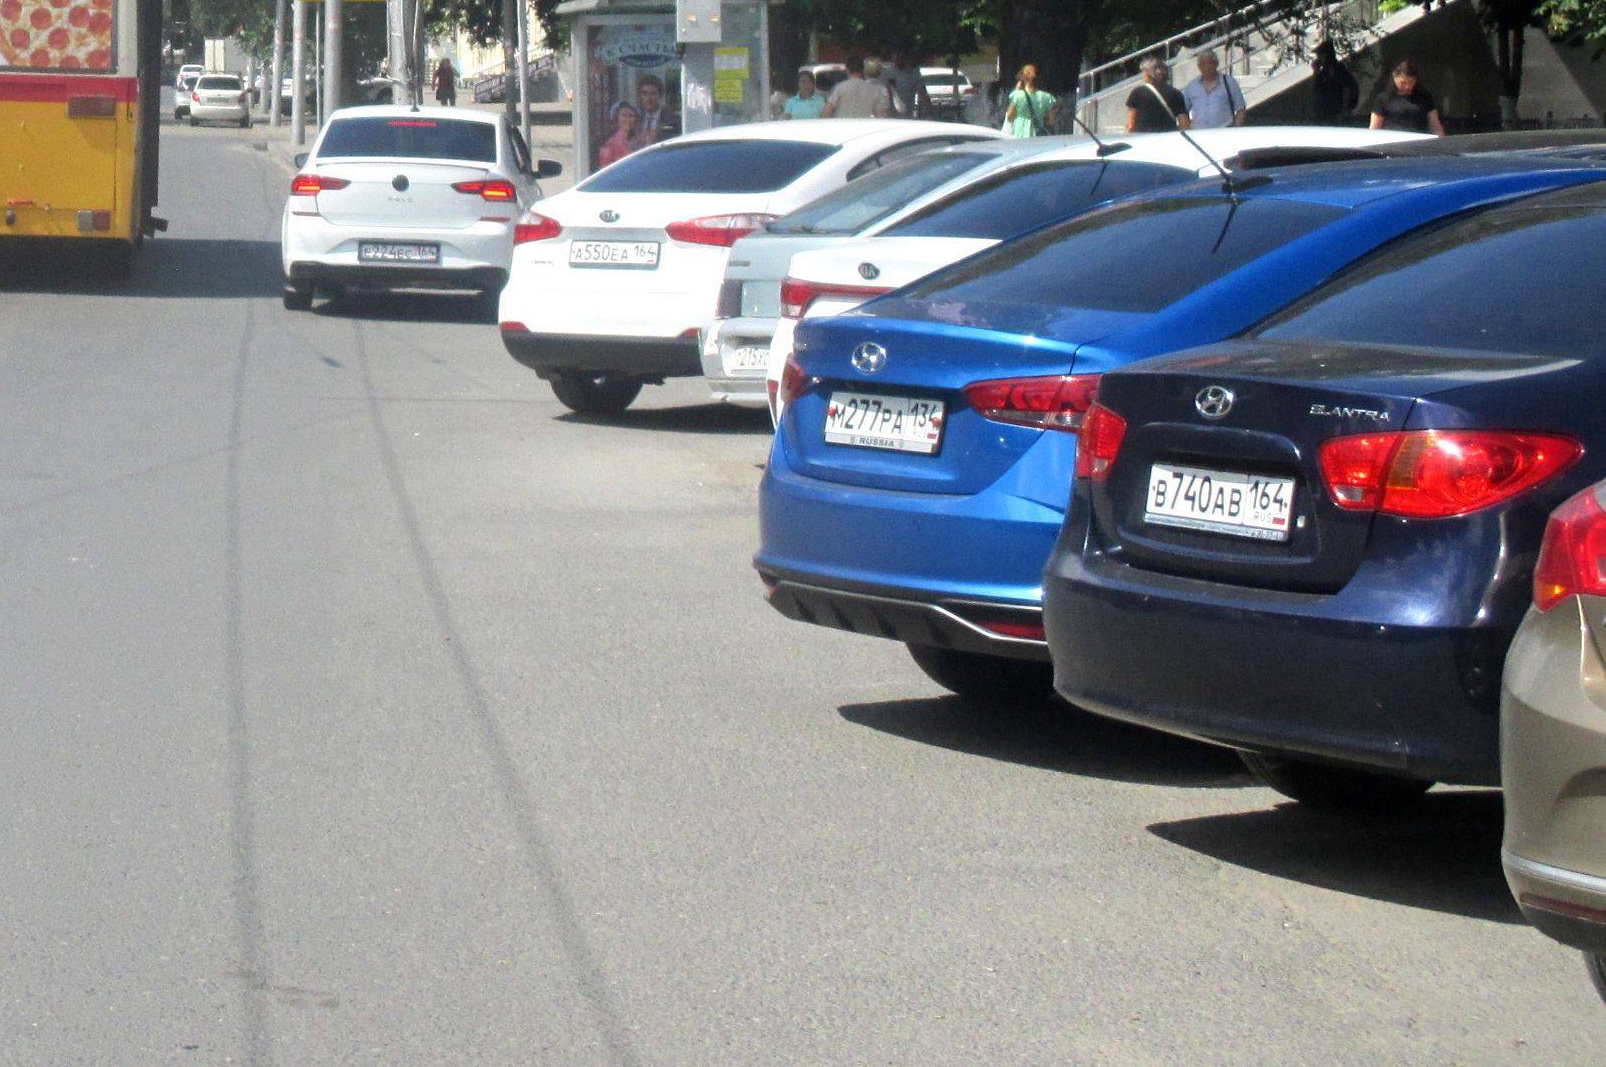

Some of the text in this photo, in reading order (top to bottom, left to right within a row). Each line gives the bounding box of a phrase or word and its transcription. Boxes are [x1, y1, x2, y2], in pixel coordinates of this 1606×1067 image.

[574, 243, 656, 261] А550ЕА 164
[832, 397, 904, 435] М277РА
[859, 437, 895, 448] RUSSIA
[1154, 471, 1285, 518] В740АВ 164
